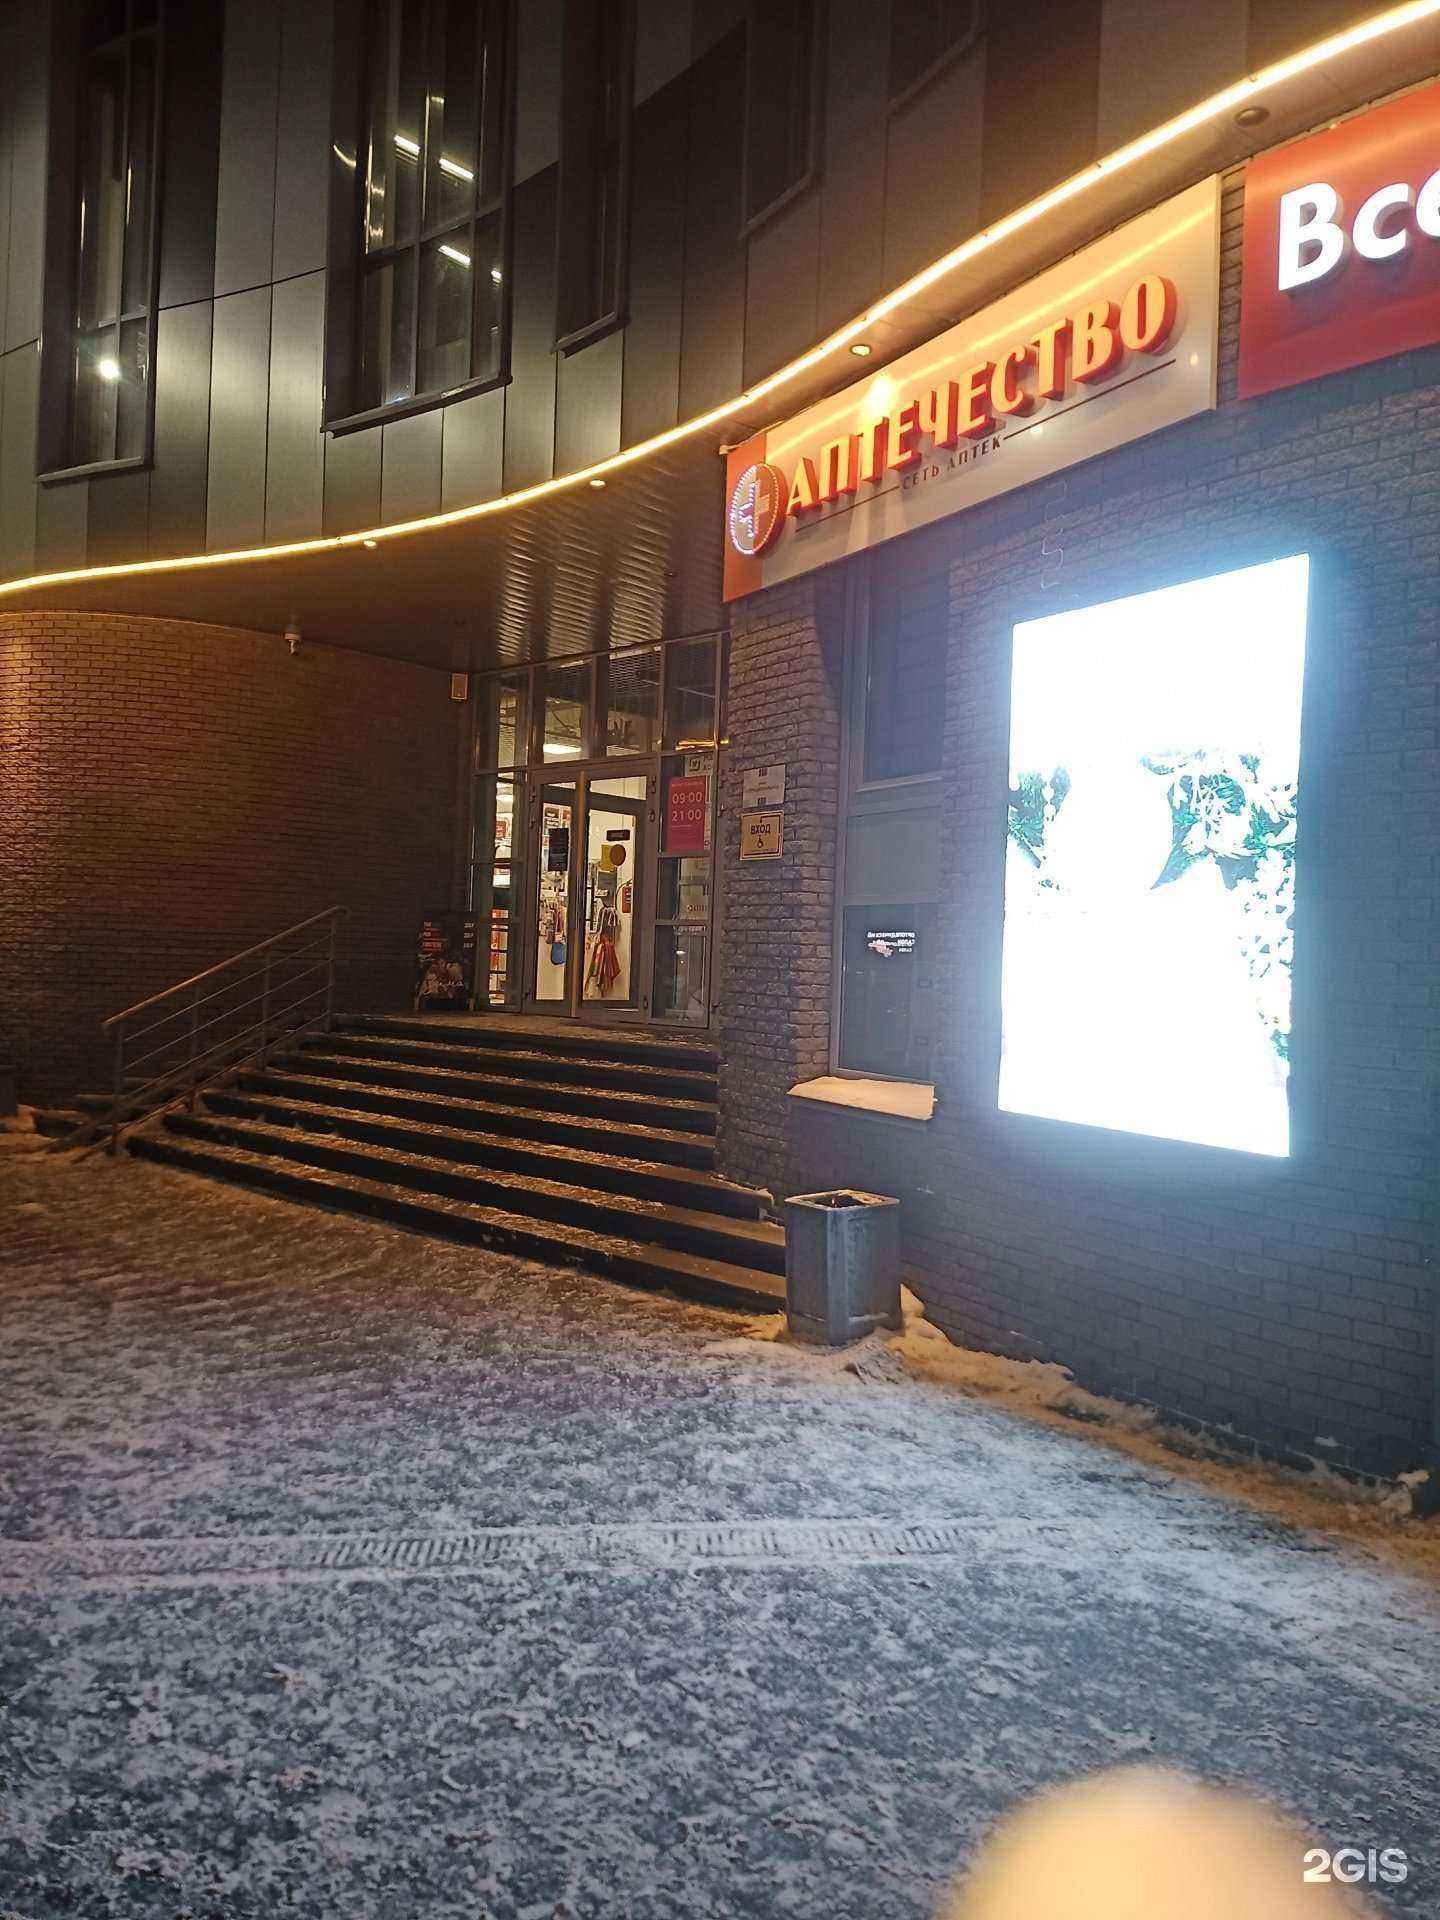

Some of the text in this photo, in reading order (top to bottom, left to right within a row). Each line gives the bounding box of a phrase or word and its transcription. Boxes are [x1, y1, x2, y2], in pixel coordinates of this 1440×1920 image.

[786, 274, 1176, 516] АПТЕЧЕСТВО
[902, 435, 1001, 490] СЕТЬ АПТЕК
[750, 823, 771, 835] ВХОД
